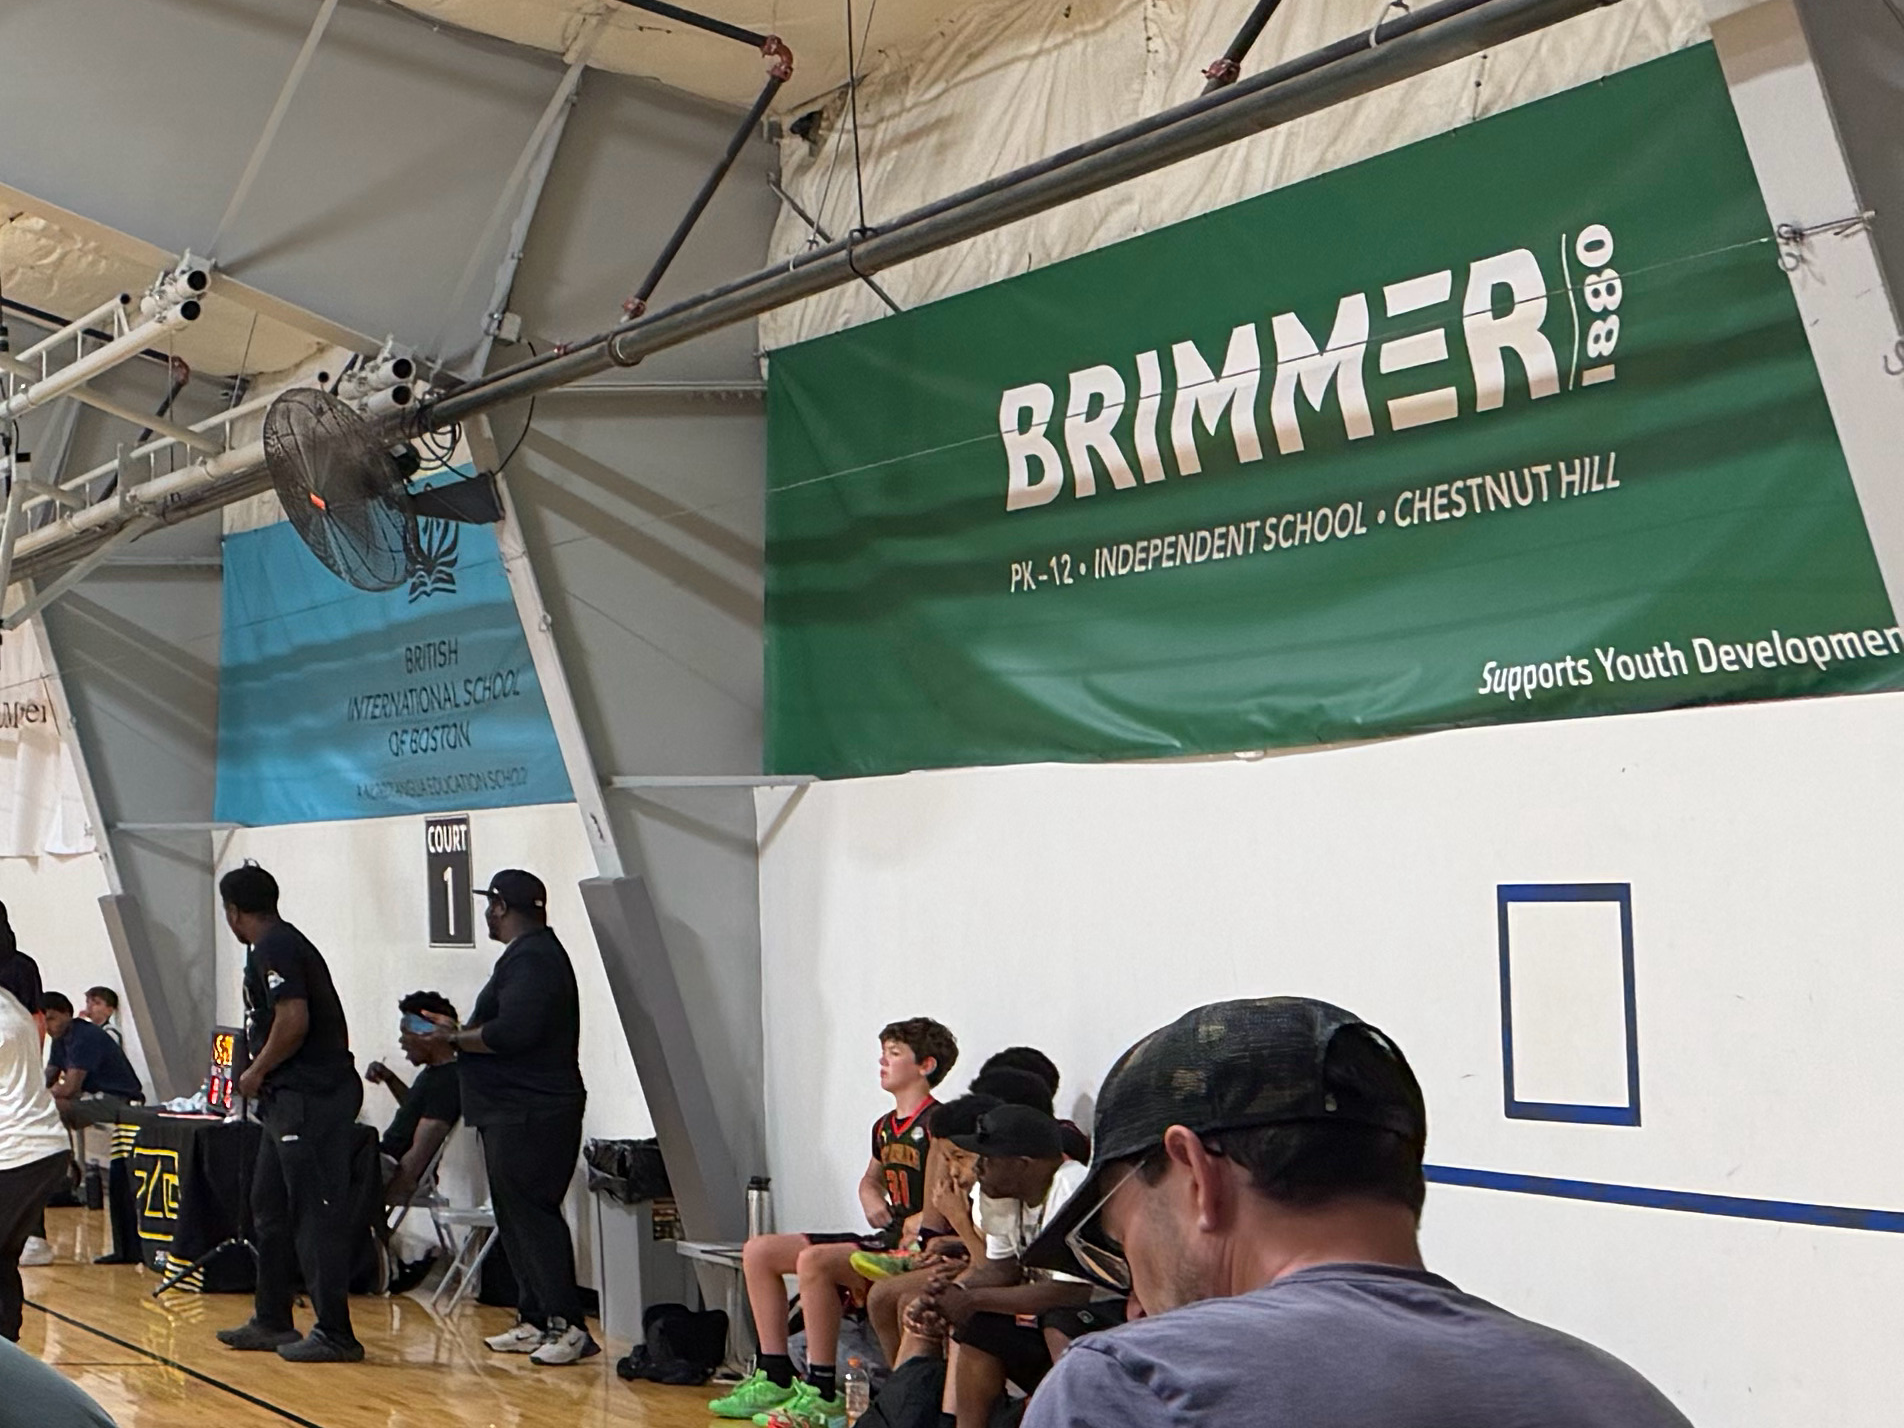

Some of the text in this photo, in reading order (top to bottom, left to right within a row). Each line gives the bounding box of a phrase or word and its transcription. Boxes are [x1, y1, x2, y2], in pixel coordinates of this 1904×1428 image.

[1575, 224, 1623, 387] 1880
[998, 248, 1561, 511] BRIMMER
[1095, 521, 1260, 579] INDEPENDENT
[1263, 501, 1367, 552] SCHOOL
[1394, 464, 1552, 527] CHESTNUT
[1558, 451, 1620, 499] HILL
[405, 637, 458, 674] BRITISH
[1478, 655, 1593, 701] Supports
[1594, 640, 1689, 683] Youth
[347, 668, 521, 722] INTERNATIONAL SCHOOL
[388, 721, 472, 757] OF BOSTON
[428, 824, 467, 853] COURT
[443, 866, 455, 936] 1
